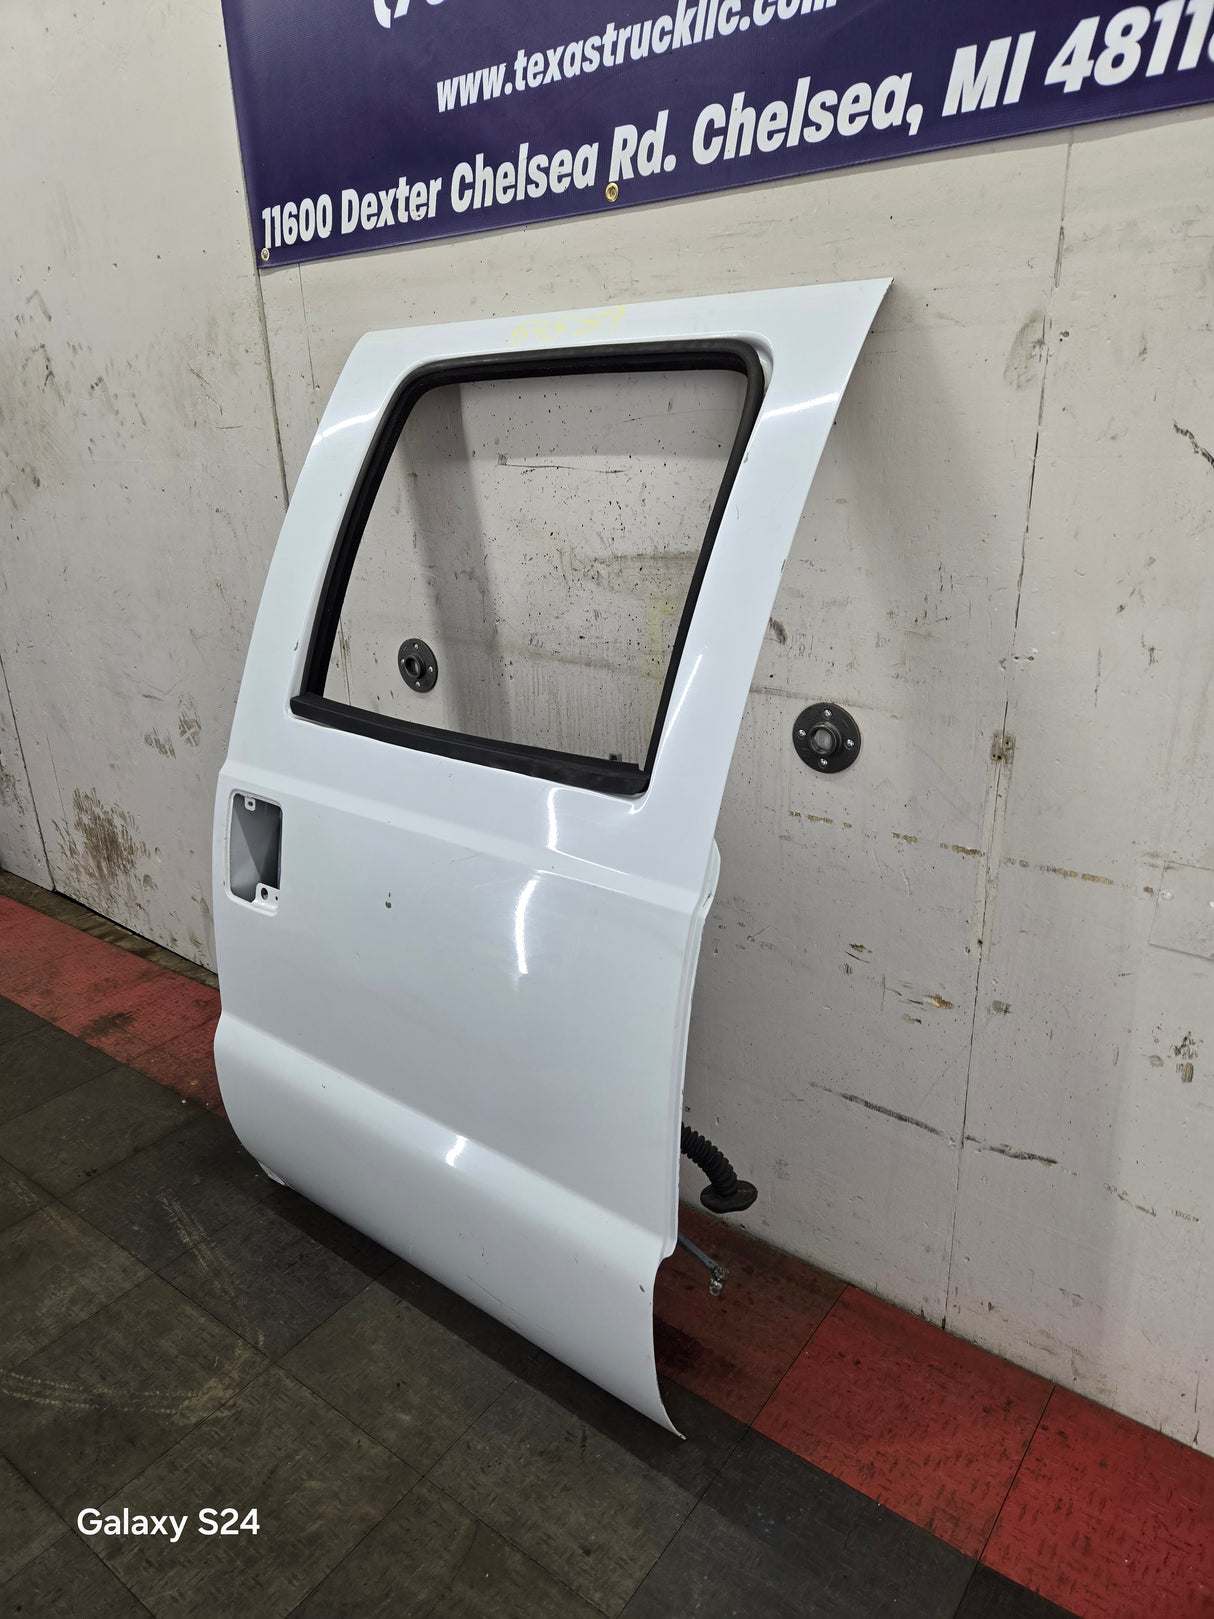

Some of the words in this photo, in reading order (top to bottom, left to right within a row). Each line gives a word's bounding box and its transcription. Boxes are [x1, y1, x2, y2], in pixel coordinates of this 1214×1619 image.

[262, 194, 332, 248] 11600
[341, 176, 442, 234] Dexter
[450, 142, 599, 212] Chelsea
[609, 109, 676, 182] Rd.
[692, 72, 924, 165] Chelsea,
[941, 30, 1036, 117] MI
[1044, 0, 1214, 93] 4811
[436, 0, 837, 112] www.texastruckllc.co
